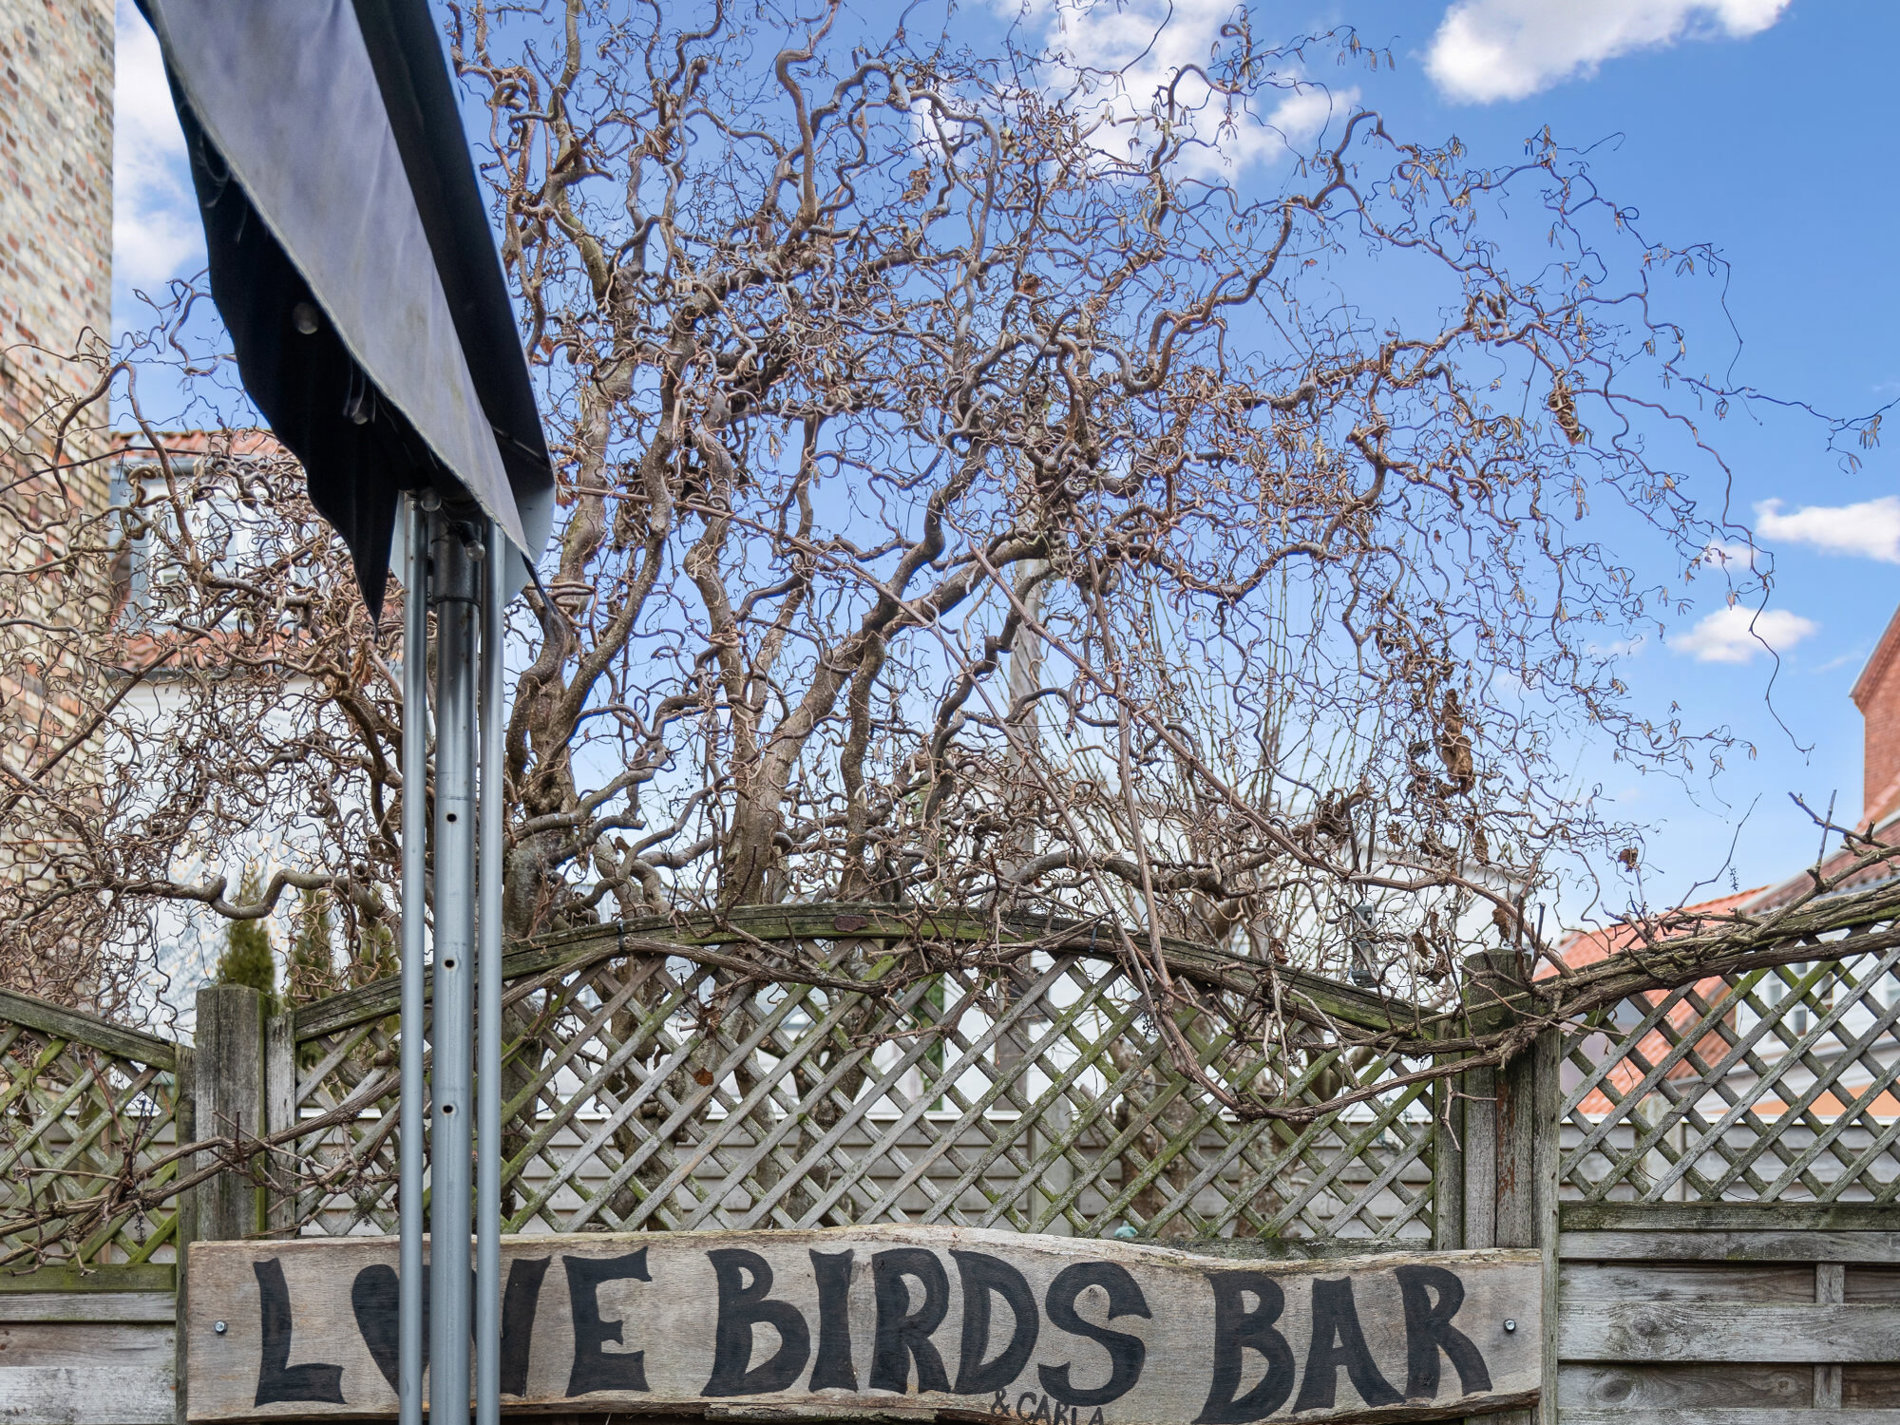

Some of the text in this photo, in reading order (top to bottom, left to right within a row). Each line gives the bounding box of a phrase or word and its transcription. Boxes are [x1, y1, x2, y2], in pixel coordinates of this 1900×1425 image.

[700, 1247, 1153, 1407] BIRDS
[1191, 1264, 1493, 1425] BAR
[990, 1388, 1010, 1416] &
